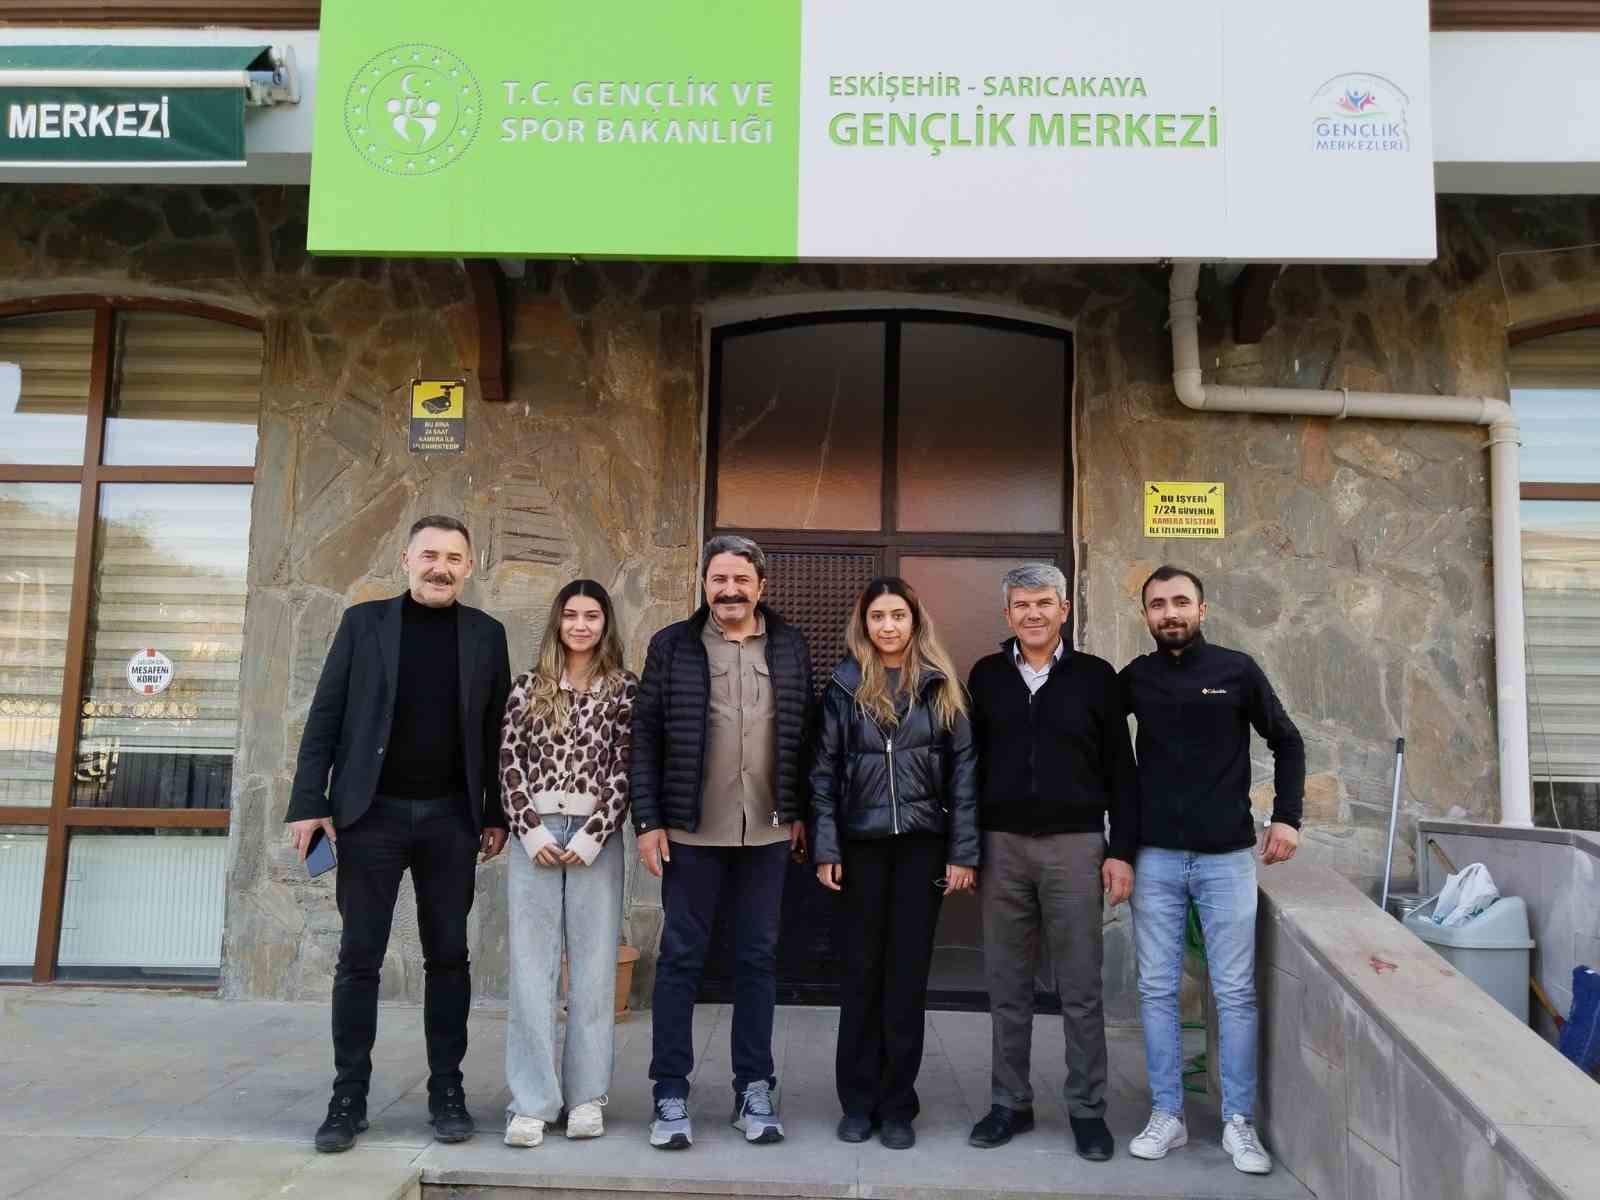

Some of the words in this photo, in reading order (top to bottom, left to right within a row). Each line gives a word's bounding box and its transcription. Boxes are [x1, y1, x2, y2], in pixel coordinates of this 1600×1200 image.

[500, 80, 560, 106] T.C.
[572, 75, 719, 113] GENÇLİK
[729, 81, 775, 108] VE
[828, 71, 962, 103] ESKİŞEHİR
[983, 75, 1149, 98] SARICAKAYA
[8, 95, 171, 139] MERKEZİ
[500, 116, 586, 144] SPOR
[596, 113, 774, 144] BAKANLIĞI
[828, 104, 1017, 157] GENÇLİK
[1027, 105, 1219, 148] MERKEZİ
[1151, 517, 1184, 526] KAMERA
[1153, 505, 1176, 515] 7/24
